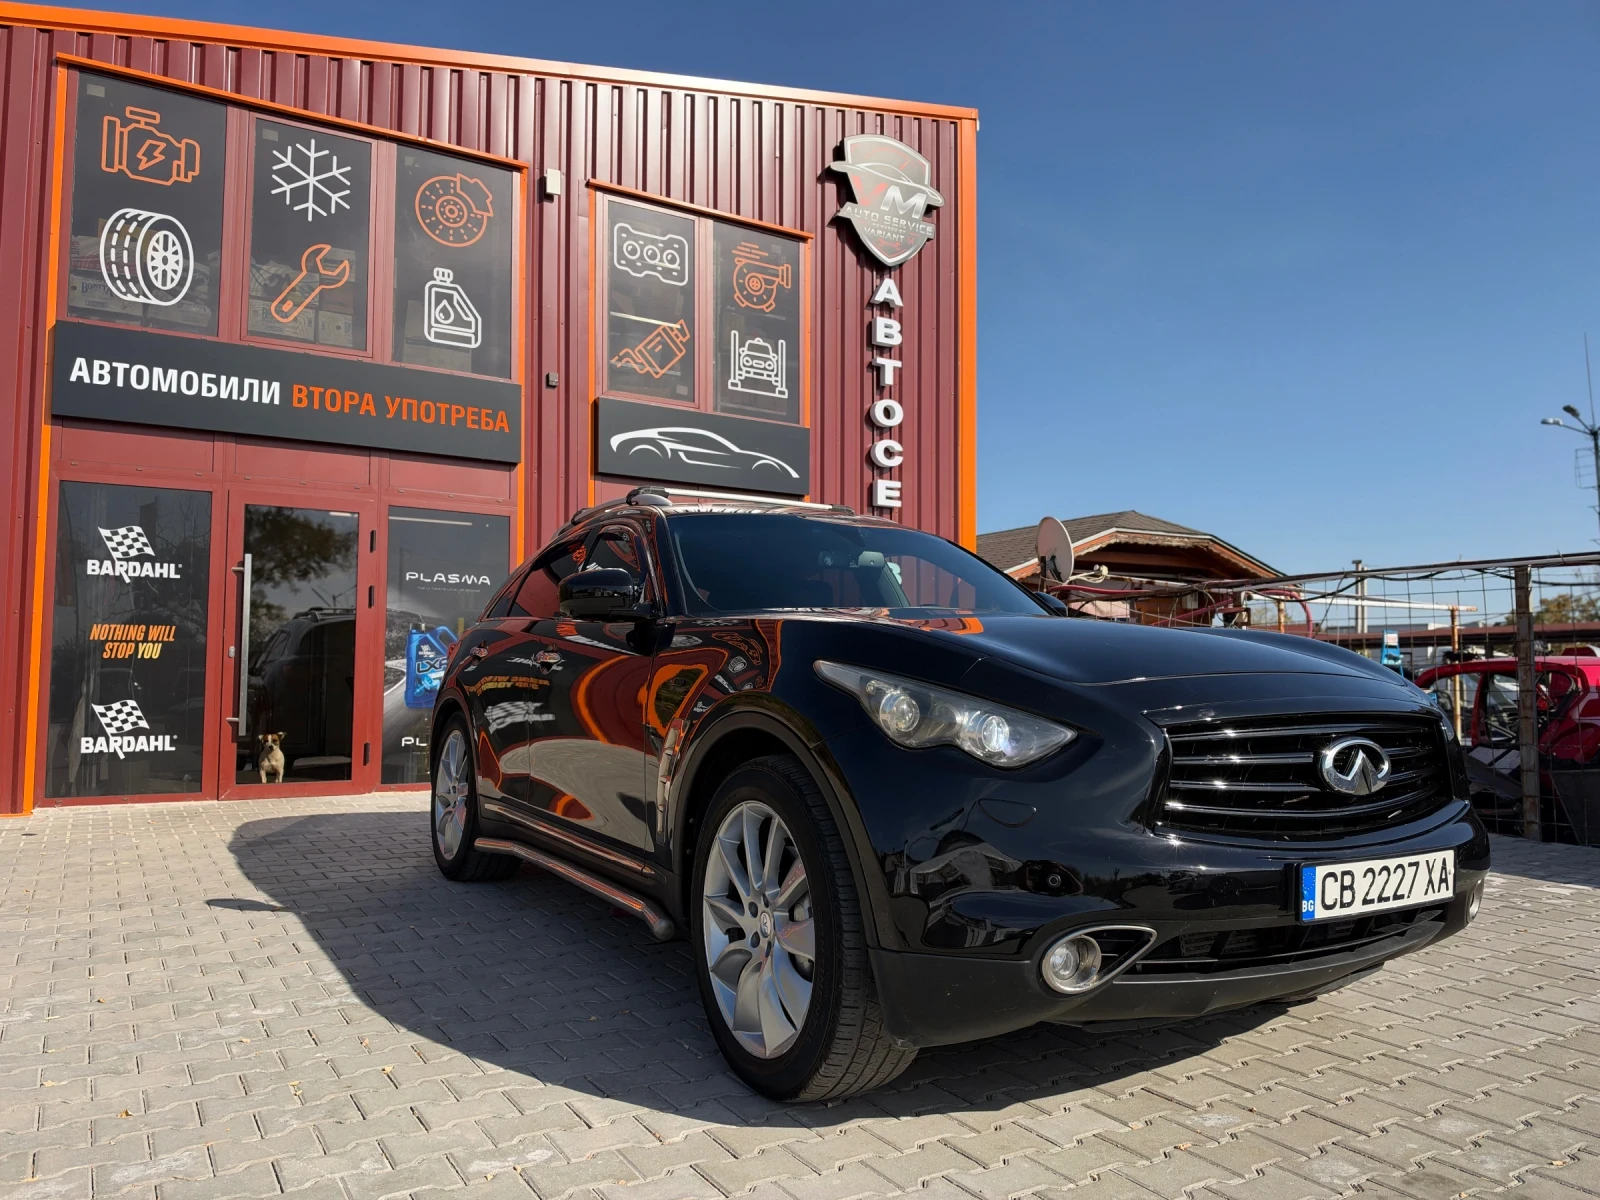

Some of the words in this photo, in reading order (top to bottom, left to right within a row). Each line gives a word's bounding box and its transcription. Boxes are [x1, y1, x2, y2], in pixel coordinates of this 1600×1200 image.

[844, 206, 879, 222] AUTO
[883, 215, 933, 236] SERVICE
[864, 226, 905, 242] VARIANT
[69, 357, 281, 405] АВТОМОБИЛИ
[292, 384, 377, 416] ВТОРА
[384, 396, 510, 433] УПОТРЕБА
[86, 559, 181, 584] BARDAHL
[405, 571, 491, 586] PLASMA
[89, 624, 147, 641] NOTHING
[147, 625, 176, 642] WILL
[102, 642, 136, 659] STOP
[137, 643, 162, 659] YOU
[80, 735, 178, 760] BARDAHL
[1361, 861, 1420, 906] 2227
[1302, 901, 1314, 913] BG
